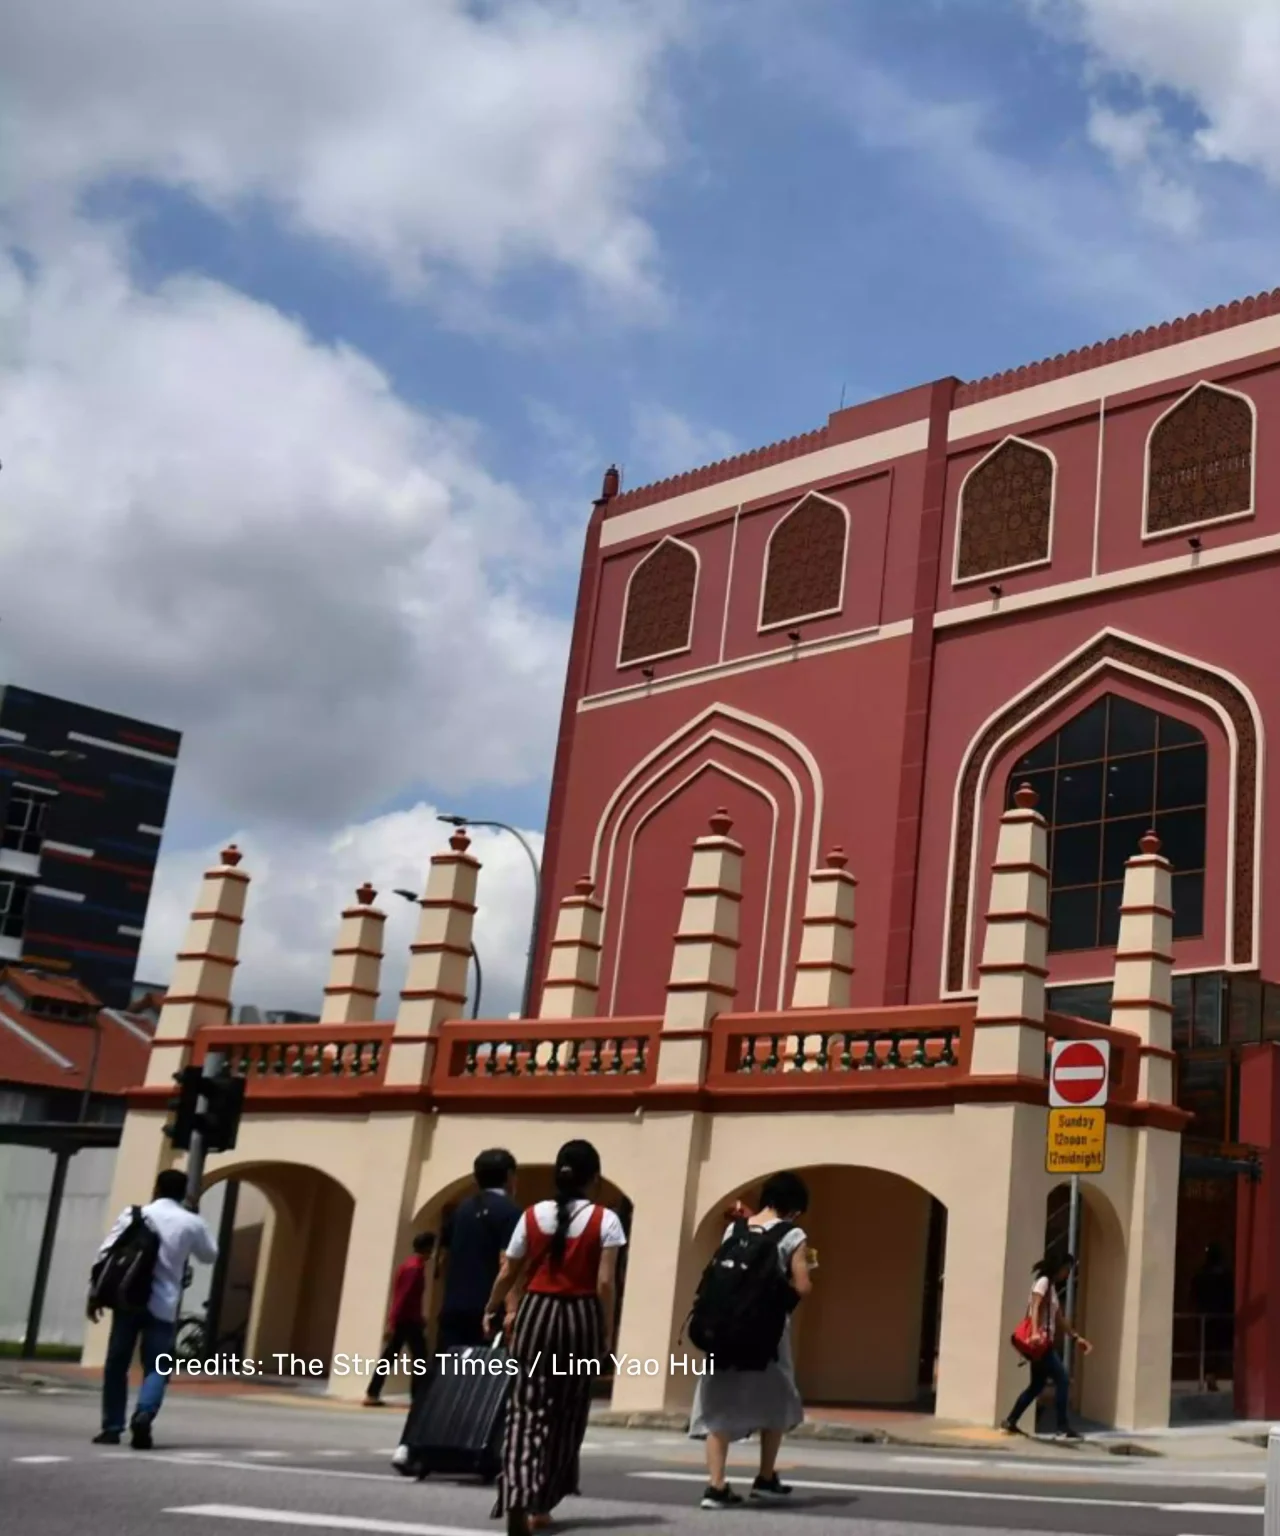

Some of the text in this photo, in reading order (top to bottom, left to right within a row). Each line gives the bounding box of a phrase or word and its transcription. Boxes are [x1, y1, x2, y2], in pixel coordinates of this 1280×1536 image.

[1058, 1114, 1095, 1130] Sunday
[1054, 1133, 1087, 1146] 12noon
[1050, 1151, 1102, 1168] 12midnight
